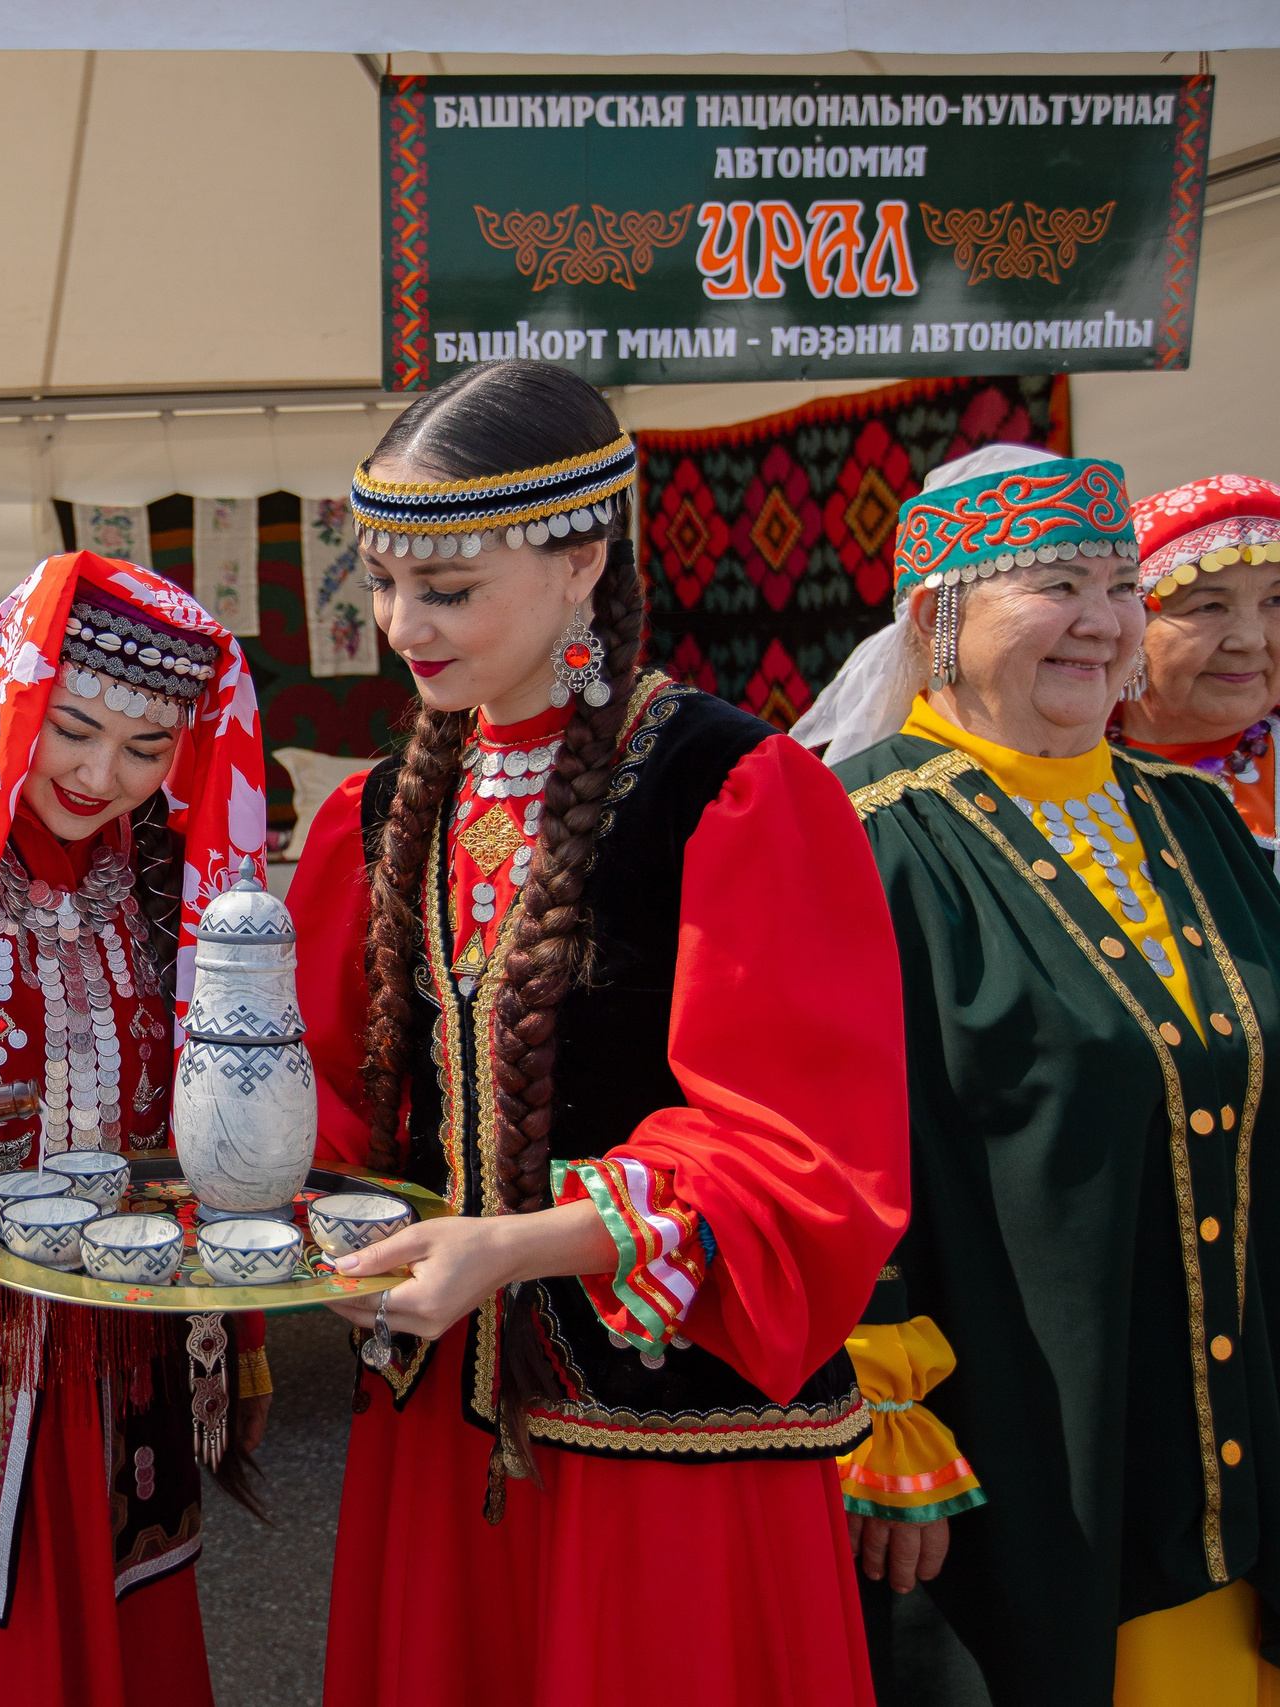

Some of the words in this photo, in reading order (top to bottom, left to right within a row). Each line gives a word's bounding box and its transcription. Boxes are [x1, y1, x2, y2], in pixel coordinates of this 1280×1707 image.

[433, 95, 686, 128] БАШКИРСКАЯ
[695, 94, 1175, 130] НАЦИОНАЛЬНО-КУЛЬТУРНАЯ
[714, 145, 927, 178] АВТОНОМИЯ
[696, 200, 918, 299] УРАЛ
[618, 327, 737, 360] МИЛЛИ
